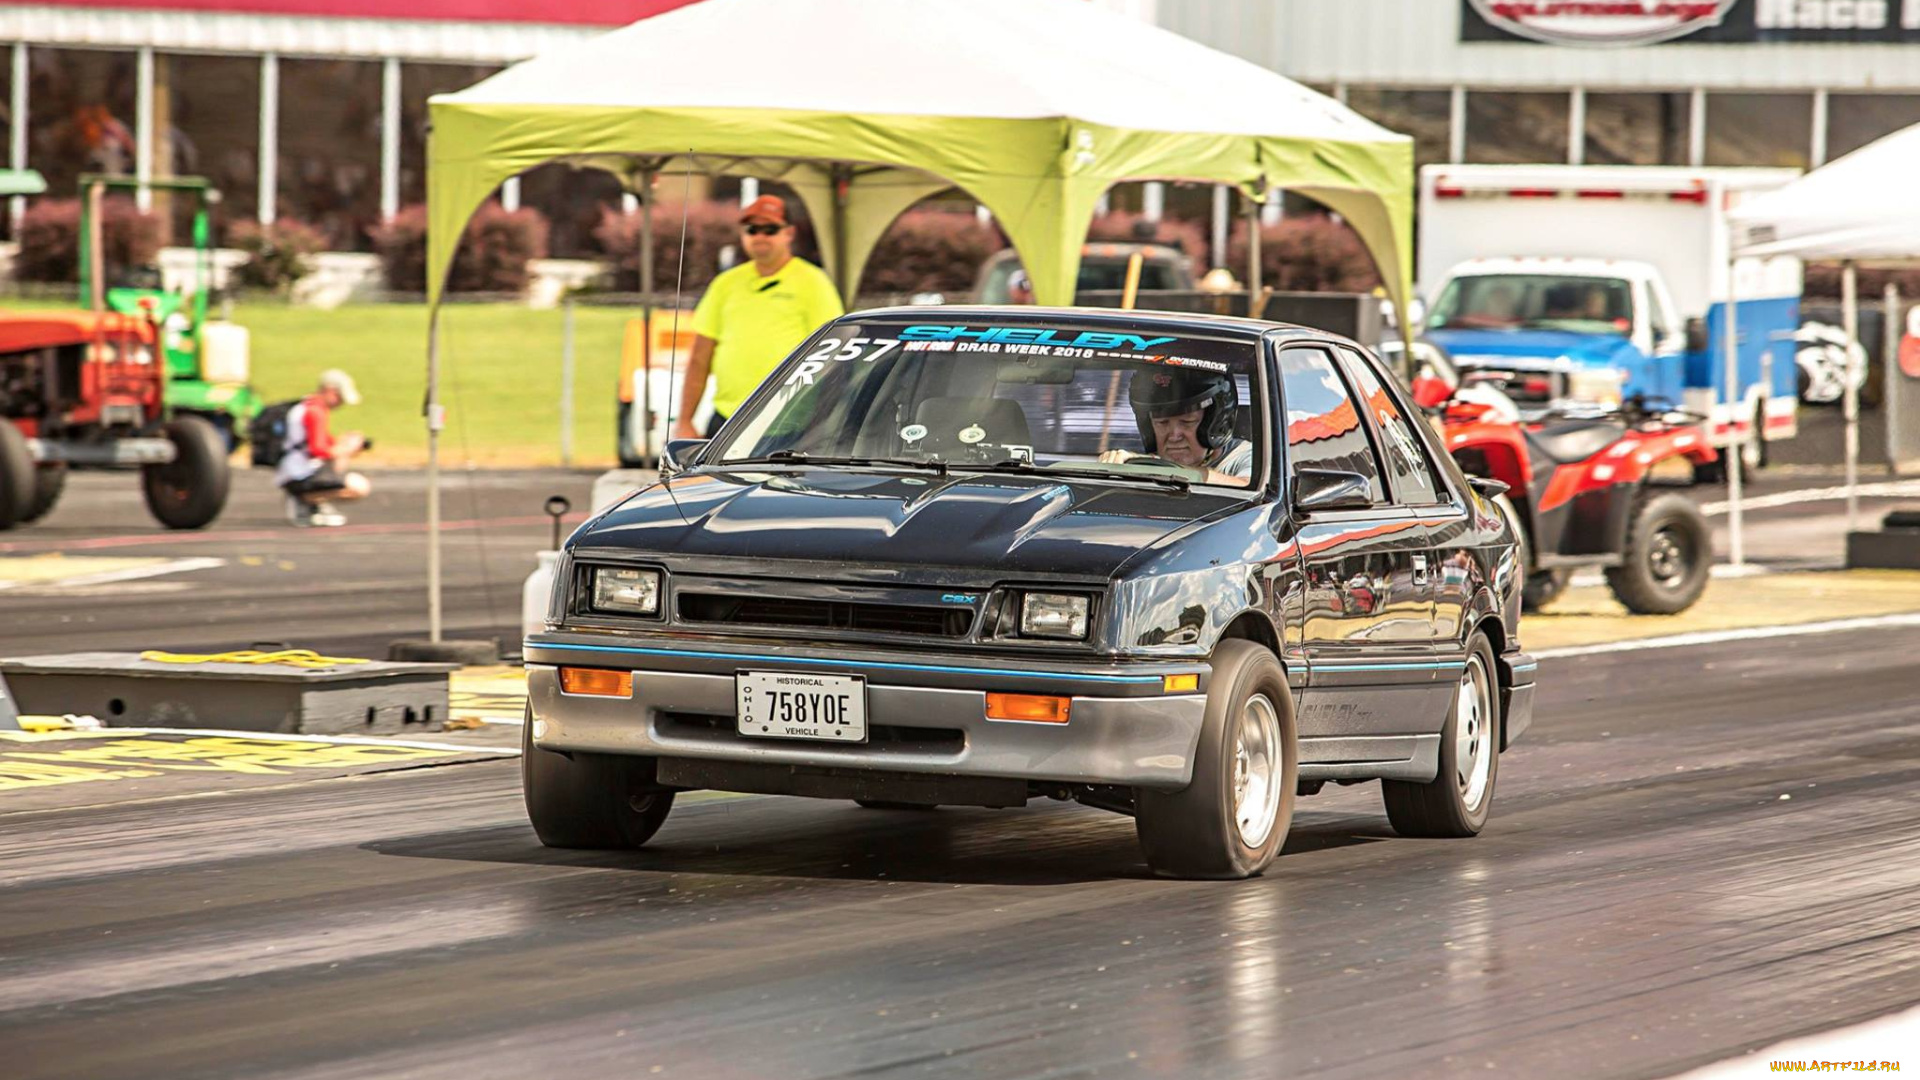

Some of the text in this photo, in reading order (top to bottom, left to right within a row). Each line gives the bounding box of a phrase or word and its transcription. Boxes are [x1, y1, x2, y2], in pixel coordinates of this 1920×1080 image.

[805, 337, 900, 362] 257
[897, 325, 1179, 350] SHELBY
[956, 342, 1001, 353] DRAG
[1005, 344, 1051, 355] WEEK
[785, 361, 825, 386] R
[776, 677, 824, 687] HISTORICAL
[743, 686, 753, 723] OHIO
[785, 727, 819, 736] VEHICLE
